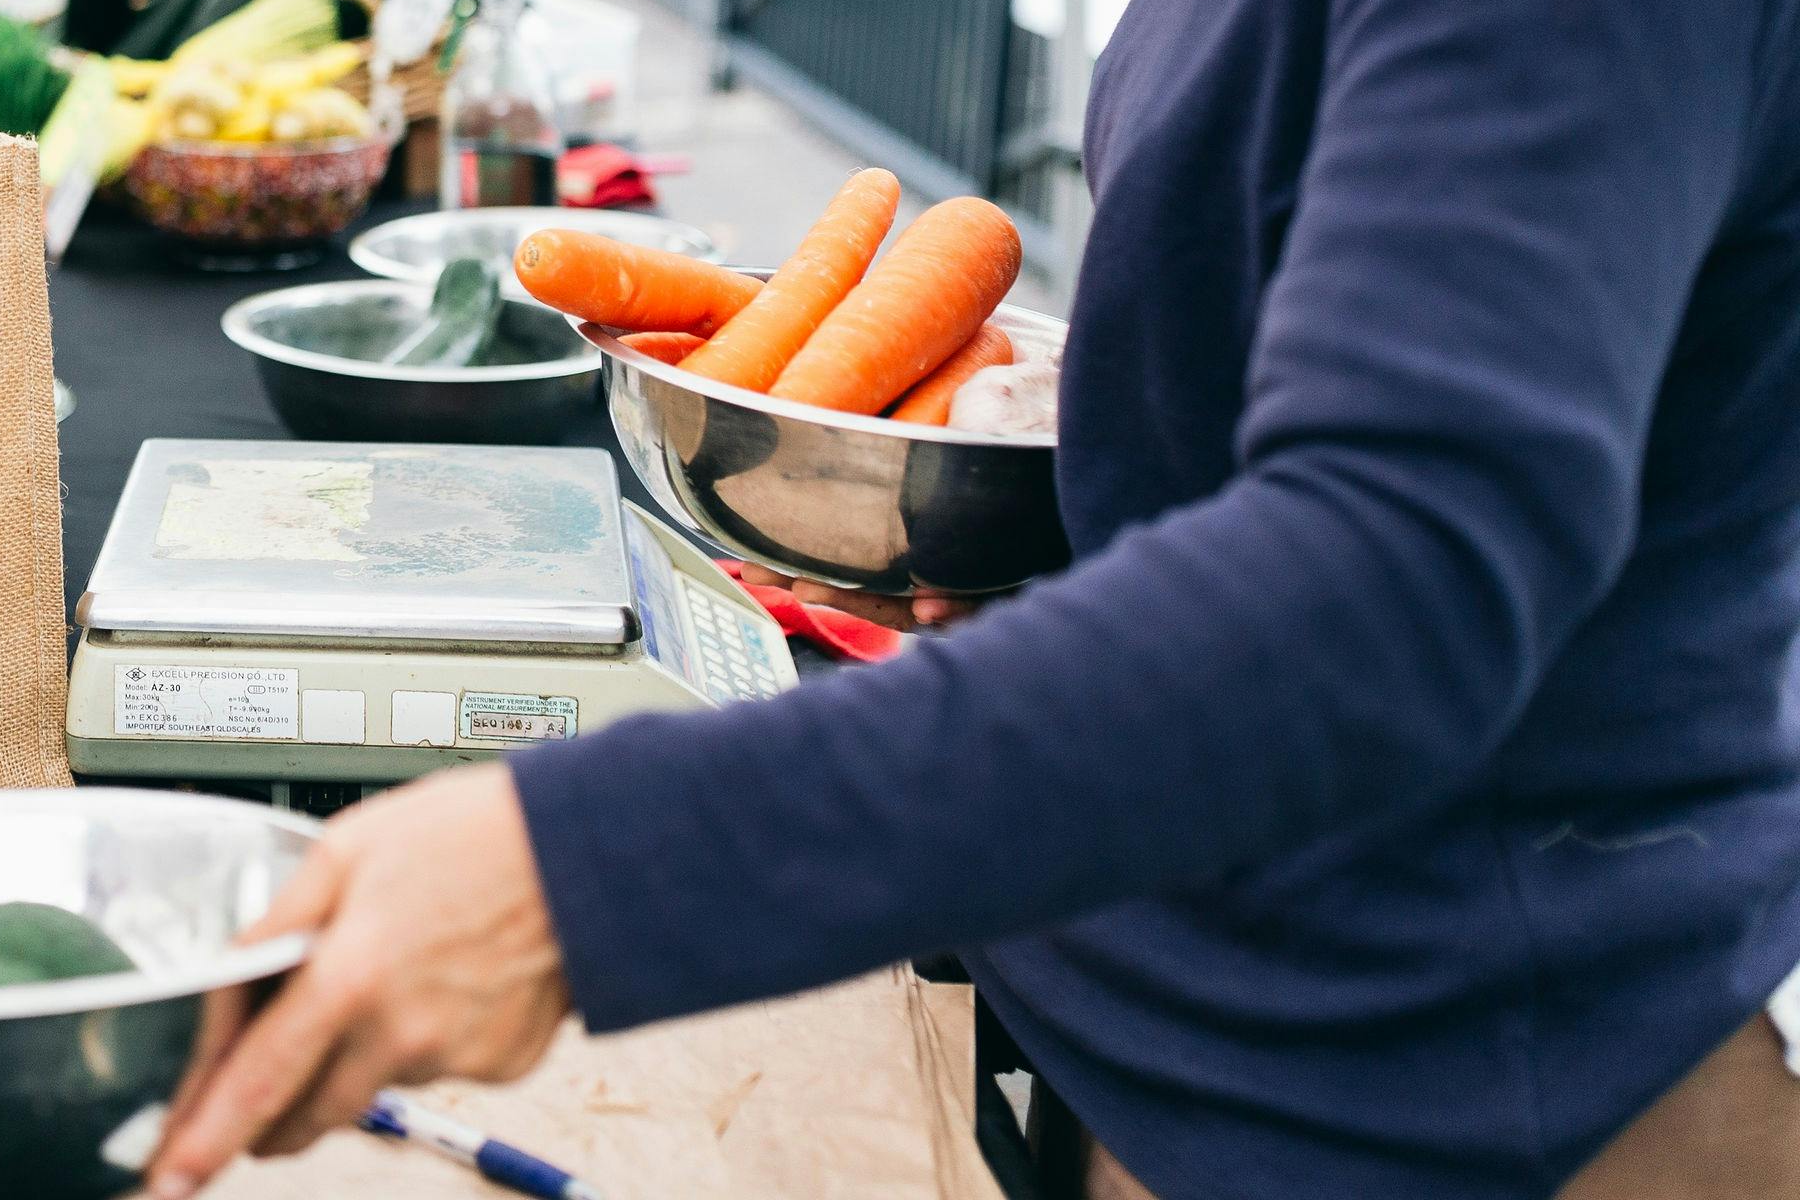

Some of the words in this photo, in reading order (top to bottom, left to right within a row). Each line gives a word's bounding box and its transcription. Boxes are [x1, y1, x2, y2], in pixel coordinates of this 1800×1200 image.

[151, 670, 188, 679] EXCELL
[190, 671, 244, 680] PRECISION
[151, 683, 181, 692] AZ-30
[497, 704, 546, 713] MEASUREMENT
